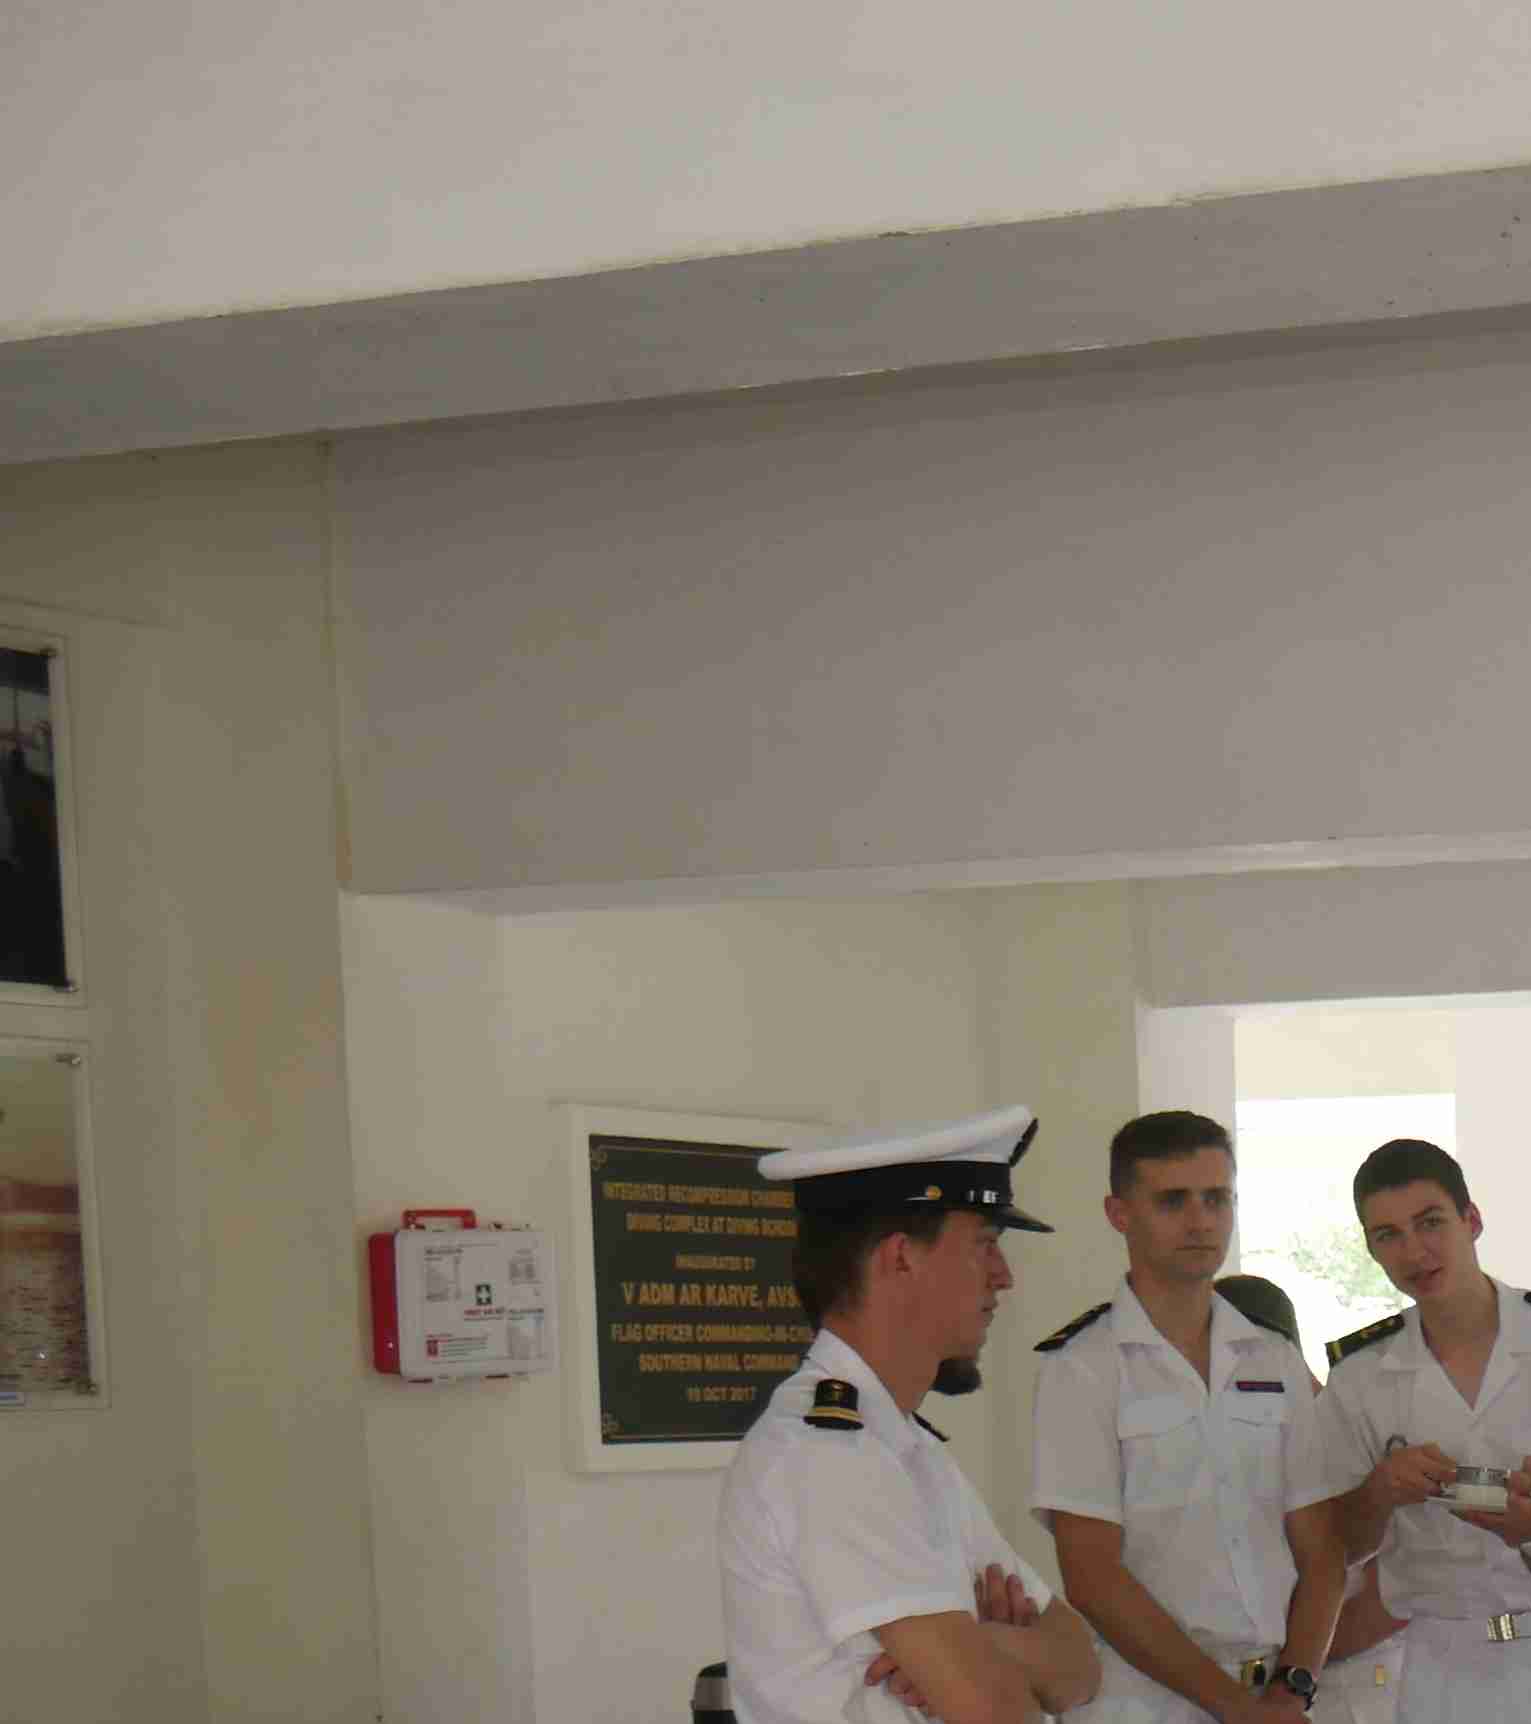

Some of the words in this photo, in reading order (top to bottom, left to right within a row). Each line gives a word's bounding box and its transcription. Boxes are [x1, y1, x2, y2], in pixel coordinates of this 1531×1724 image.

[621, 1282, 635, 1305] V
[638, 1283, 674, 1306] ADM
[679, 1283, 703, 1306] AR
[705, 1284, 763, 1310] KARVE,
[610, 1322, 642, 1343] FLAG
[644, 1323, 694, 1343] OFFICER
[638, 1353, 702, 1372] SOUTHERN
[703, 1386, 727, 1402] OCT
